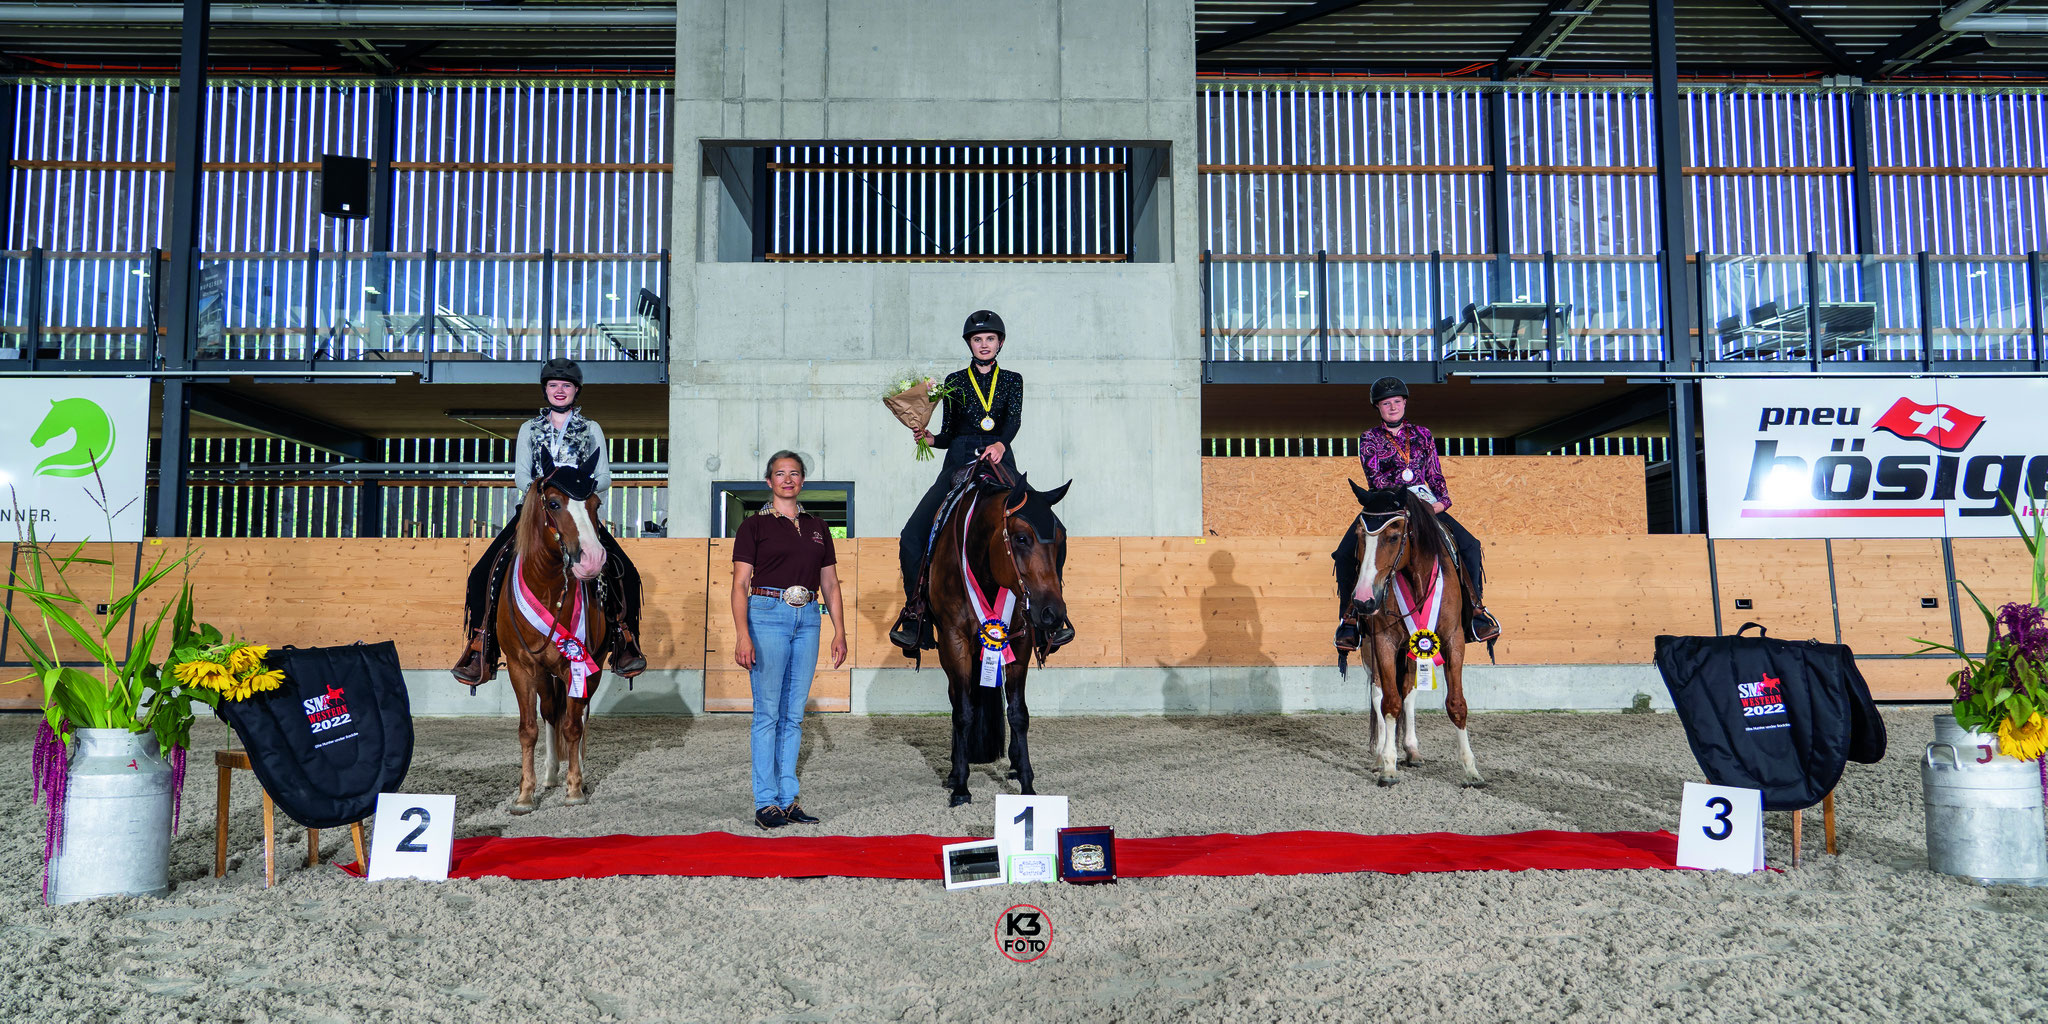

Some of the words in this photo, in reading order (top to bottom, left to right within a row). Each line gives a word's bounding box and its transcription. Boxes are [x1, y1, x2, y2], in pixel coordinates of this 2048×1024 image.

[1758, 407, 1861, 432] pneu
[1741, 694, 1782, 707] WESTERN
[1743, 703, 1785, 717] 2022
[308, 704, 348, 724] WESTERN
[311, 713, 352, 734] 2022
[396, 807, 431, 852] 2
[1014, 806, 1034, 851] 1
[1702, 796, 1733, 841] 3
